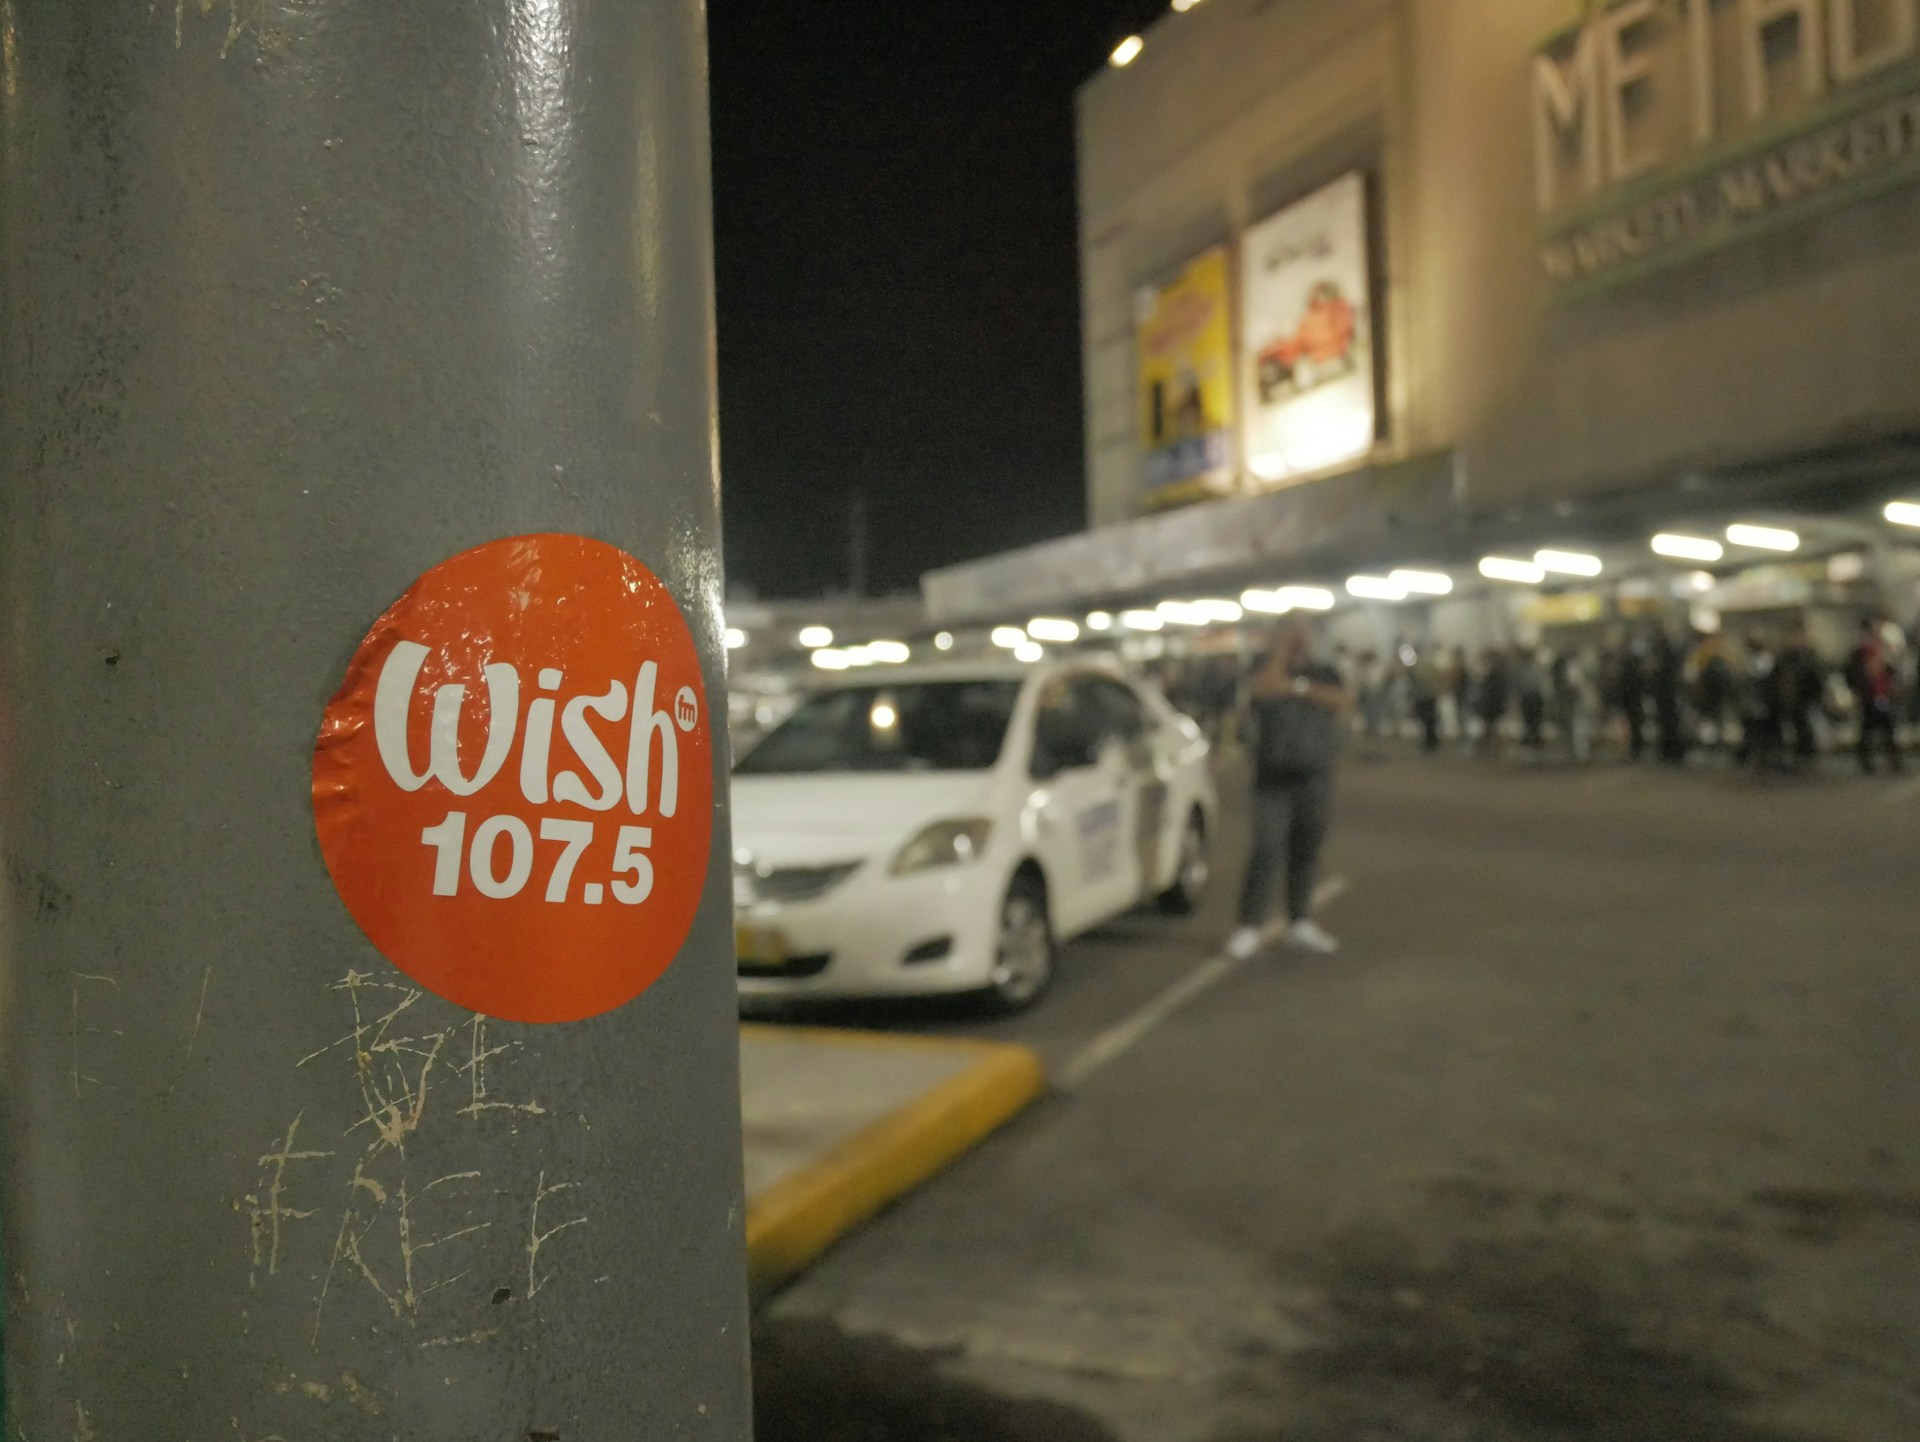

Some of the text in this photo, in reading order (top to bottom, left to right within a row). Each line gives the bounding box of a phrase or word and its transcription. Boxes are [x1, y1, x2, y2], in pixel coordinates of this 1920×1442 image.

[374, 640, 695, 818] Wish fm
[421, 811, 654, 905] 107.5
